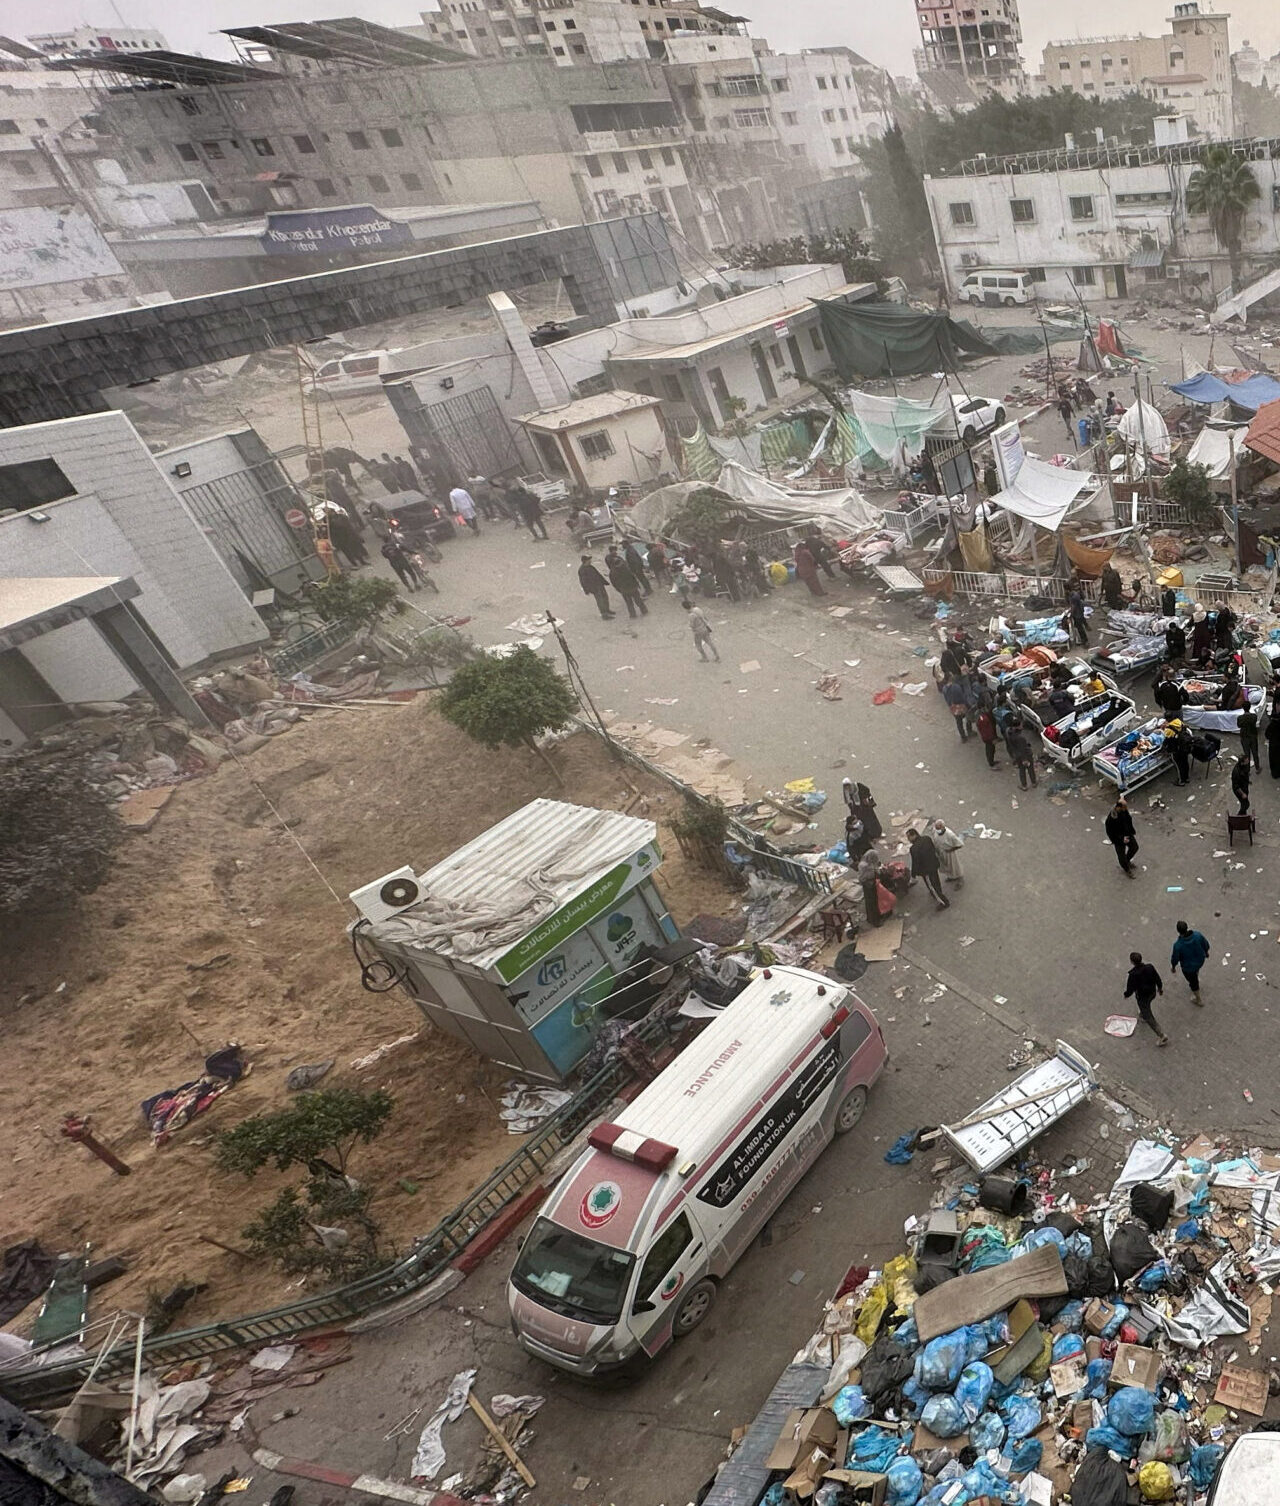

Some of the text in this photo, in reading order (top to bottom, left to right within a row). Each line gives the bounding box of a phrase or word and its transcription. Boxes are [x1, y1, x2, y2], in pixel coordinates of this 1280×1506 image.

[326, 220, 392, 238] Khozendar
[519, 880, 615, 956] معرض بيسان للاتصالات
[614, 929, 637, 954] جوال
[530, 959, 594, 1012] بيسان للاتصالات
[683, 1039, 743, 1099] AMBULANCE
[795, 1048, 836, 1099] مستشفى
[800, 1053, 843, 1108] الخير
[738, 1121, 786, 1179] FOUNDATION
[784, 1108, 797, 1124] UK
